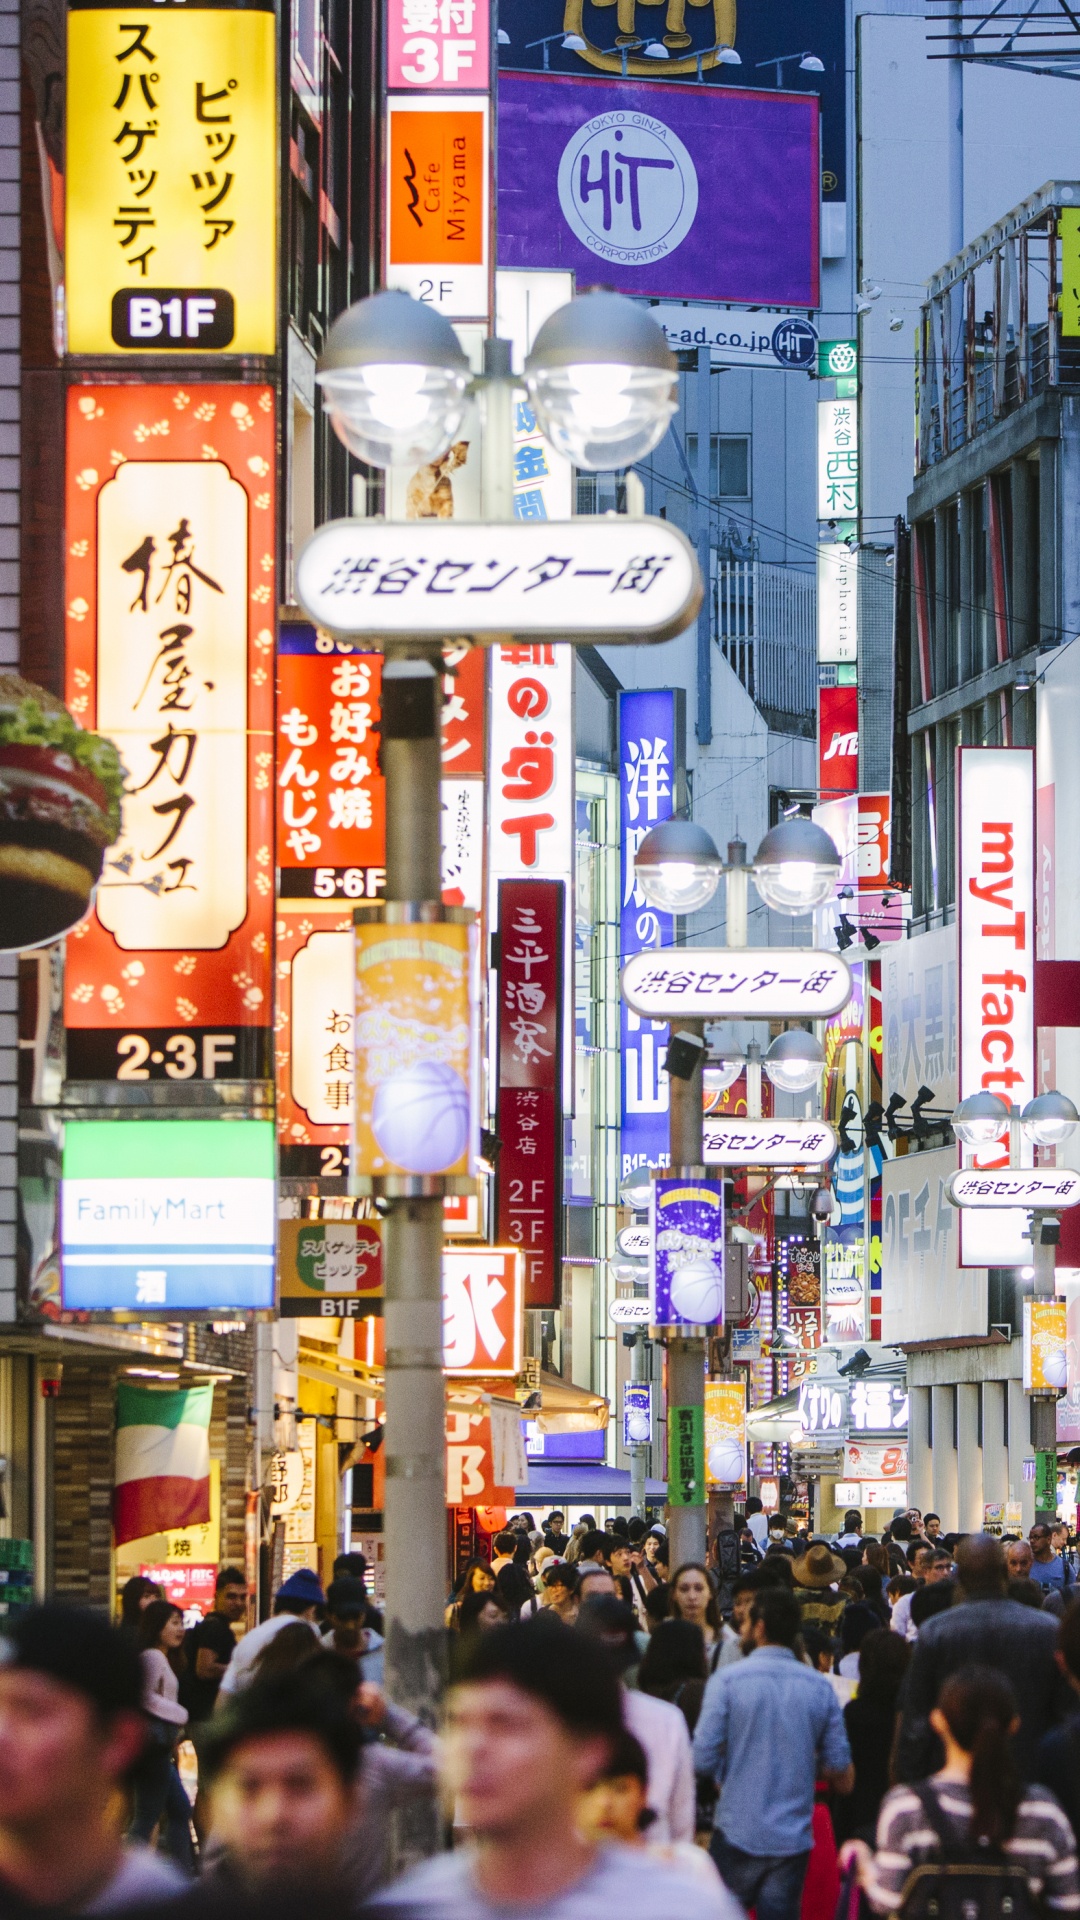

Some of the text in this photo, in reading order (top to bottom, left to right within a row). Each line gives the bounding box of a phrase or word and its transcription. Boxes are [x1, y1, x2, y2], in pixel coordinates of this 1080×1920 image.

[401, 38, 476, 83] 3F
[585, 113, 668, 139] TOKYO GINZA
[112, 23, 160, 277] スパゲッティ
[190, 78, 239, 251] ピッツァ
[424, 163, 441, 213] Cafe
[446, 136, 470, 241] Miyama
[586, 235, 669, 261] CORPORATION
[418, 279, 453, 302] 2F
[129, 297, 218, 339] B1F
[321, 556, 674, 597] 渋谷センター街
[119, 518, 225, 892] 椿屋カフェ
[327, 660, 373, 829] お好み焼
[279, 707, 321, 862] もんじゃ
[633, 970, 839, 995] 渋谷センター街
[514, 1091, 539, 1155] 渋谷店
[509, 1180, 545, 1202] 2F
[958, 1180, 1074, 1197] 渋谷センター街
[77, 1198, 226, 1226] FamilyMart
[509, 1219, 545, 1242] 3F
[302, 1239, 380, 1256] スパゲッティ
[314, 1263, 367, 1279] ピッツァ
[530, 1261, 544, 1282] F
[320, 1299, 360, 1317] B1F
